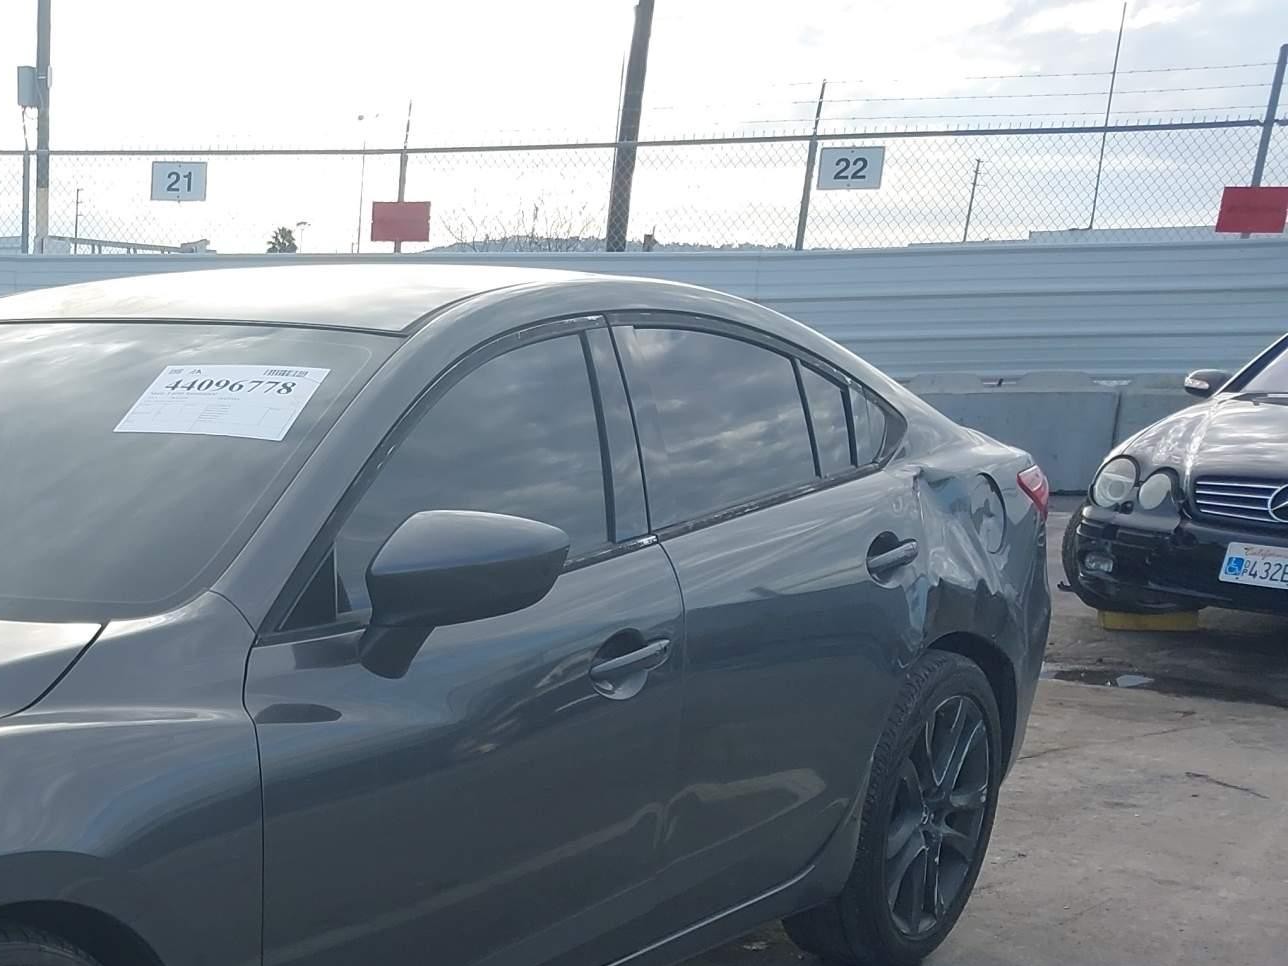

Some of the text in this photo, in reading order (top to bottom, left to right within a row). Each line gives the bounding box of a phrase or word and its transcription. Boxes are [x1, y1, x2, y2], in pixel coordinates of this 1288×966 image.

[833, 157, 868, 180] 22
[166, 171, 192, 192] 21
[165, 378, 297, 395] 44096778
